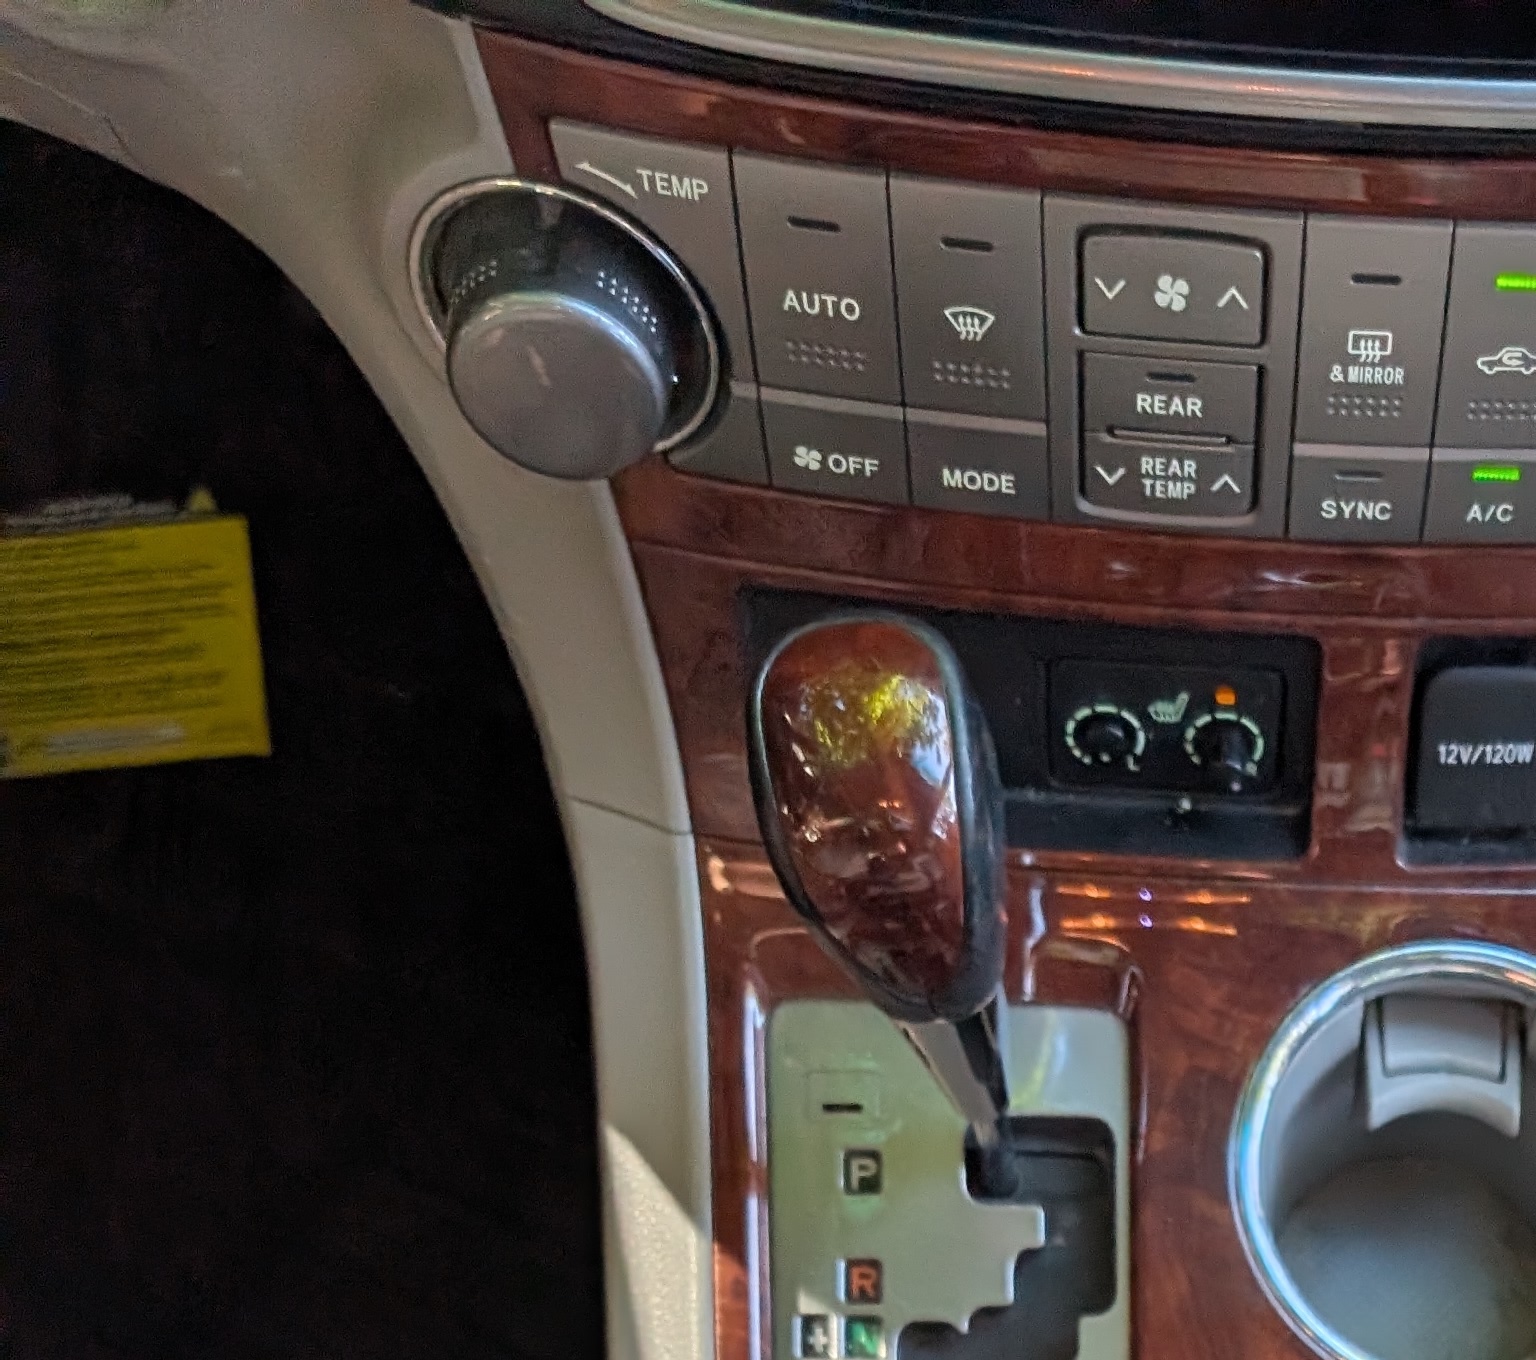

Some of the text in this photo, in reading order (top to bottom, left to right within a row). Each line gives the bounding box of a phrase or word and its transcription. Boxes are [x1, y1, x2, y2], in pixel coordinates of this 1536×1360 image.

[636, 168, 709, 201] TEMP
[783, 289, 860, 321] AUTO
[1347, 363, 1405, 386] MIRROR
[1136, 393, 1203, 418] REAR
[827, 453, 879, 477] OFF
[1140, 456, 1197, 478] REAR
[942, 467, 1016, 495] MODE
[1141, 478, 1195, 500] TEMP
[1320, 499, 1391, 521] SYNC
[1466, 503, 1514, 523] A/C
[1438, 742, 1535, 765] 12V/120W
[851, 1157, 877, 1191] P
[851, 1266, 875, 1297] R
[851, 1320, 879, 1354] N
